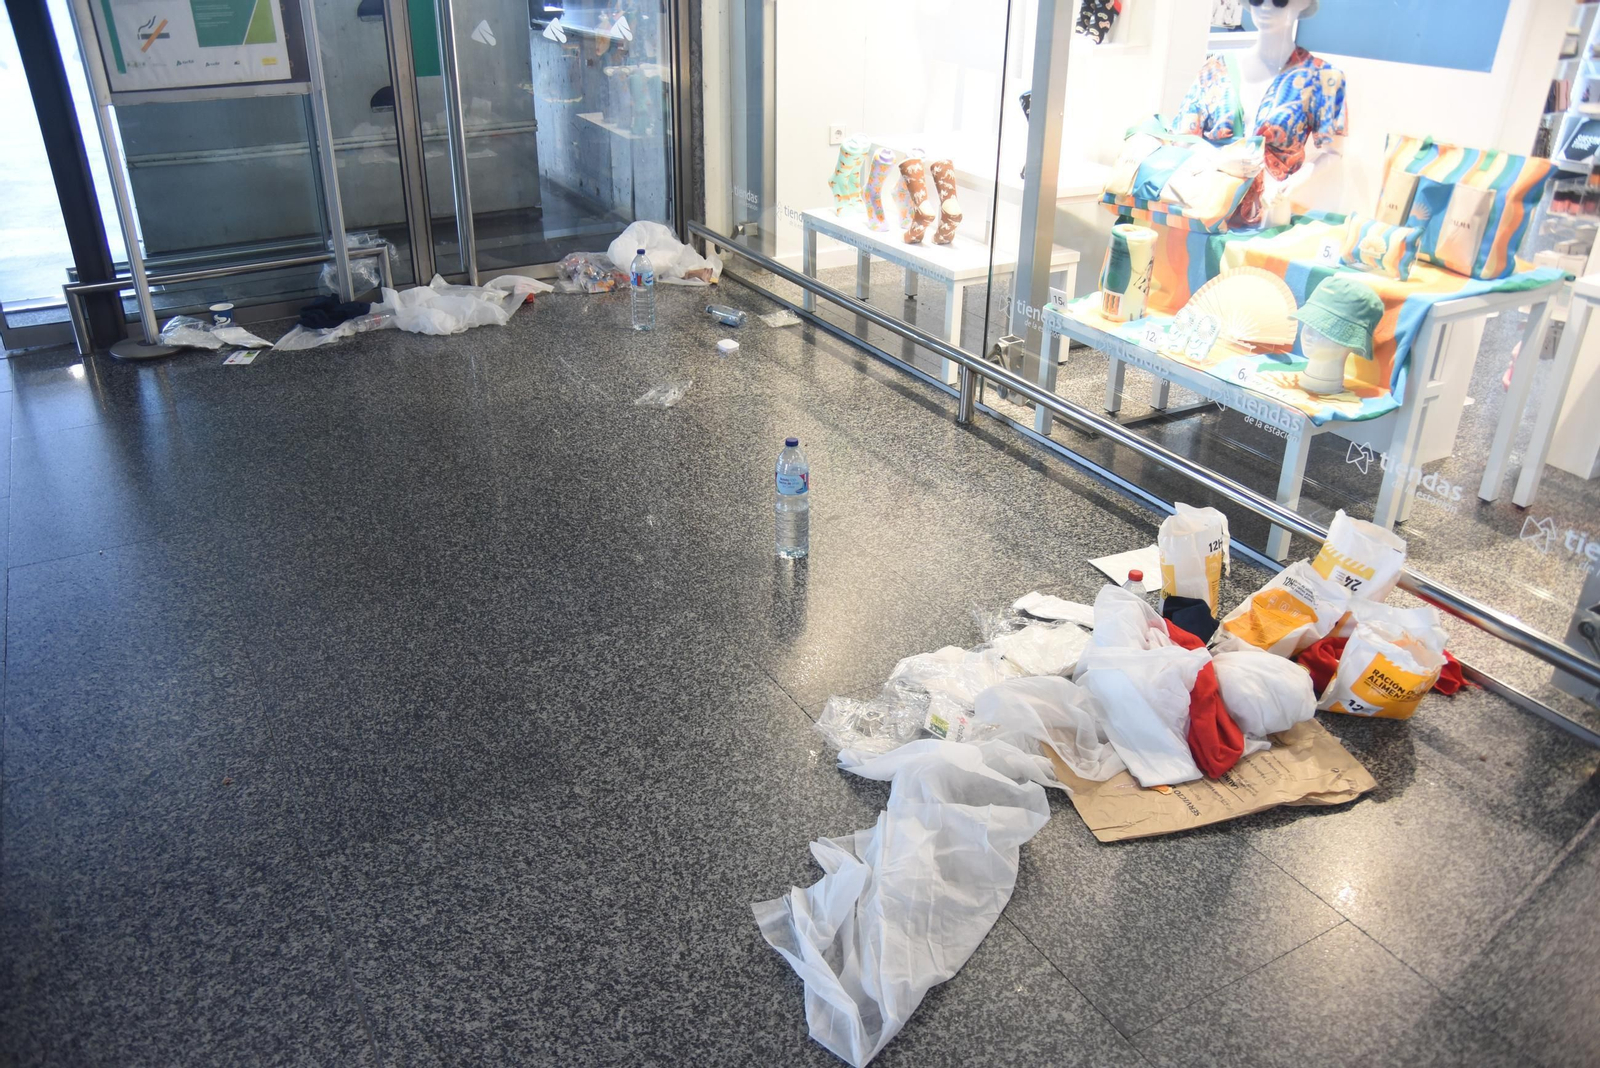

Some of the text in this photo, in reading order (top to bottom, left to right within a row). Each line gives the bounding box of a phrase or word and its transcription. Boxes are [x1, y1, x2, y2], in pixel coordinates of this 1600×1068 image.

[734, 185, 758, 204] tiendas
[1017, 299, 1062, 330] tiendas
[1234, 391, 1301, 432] tiendas
[1244, 415, 1253, 425] de
[1255, 418, 1262, 428] la
[1380, 452, 1463, 501] tiendas
[1416, 491, 1458, 514] estación
[1372, 668, 1406, 695] RACIÓN
[1173, 789, 1200, 817] SERVICIO
